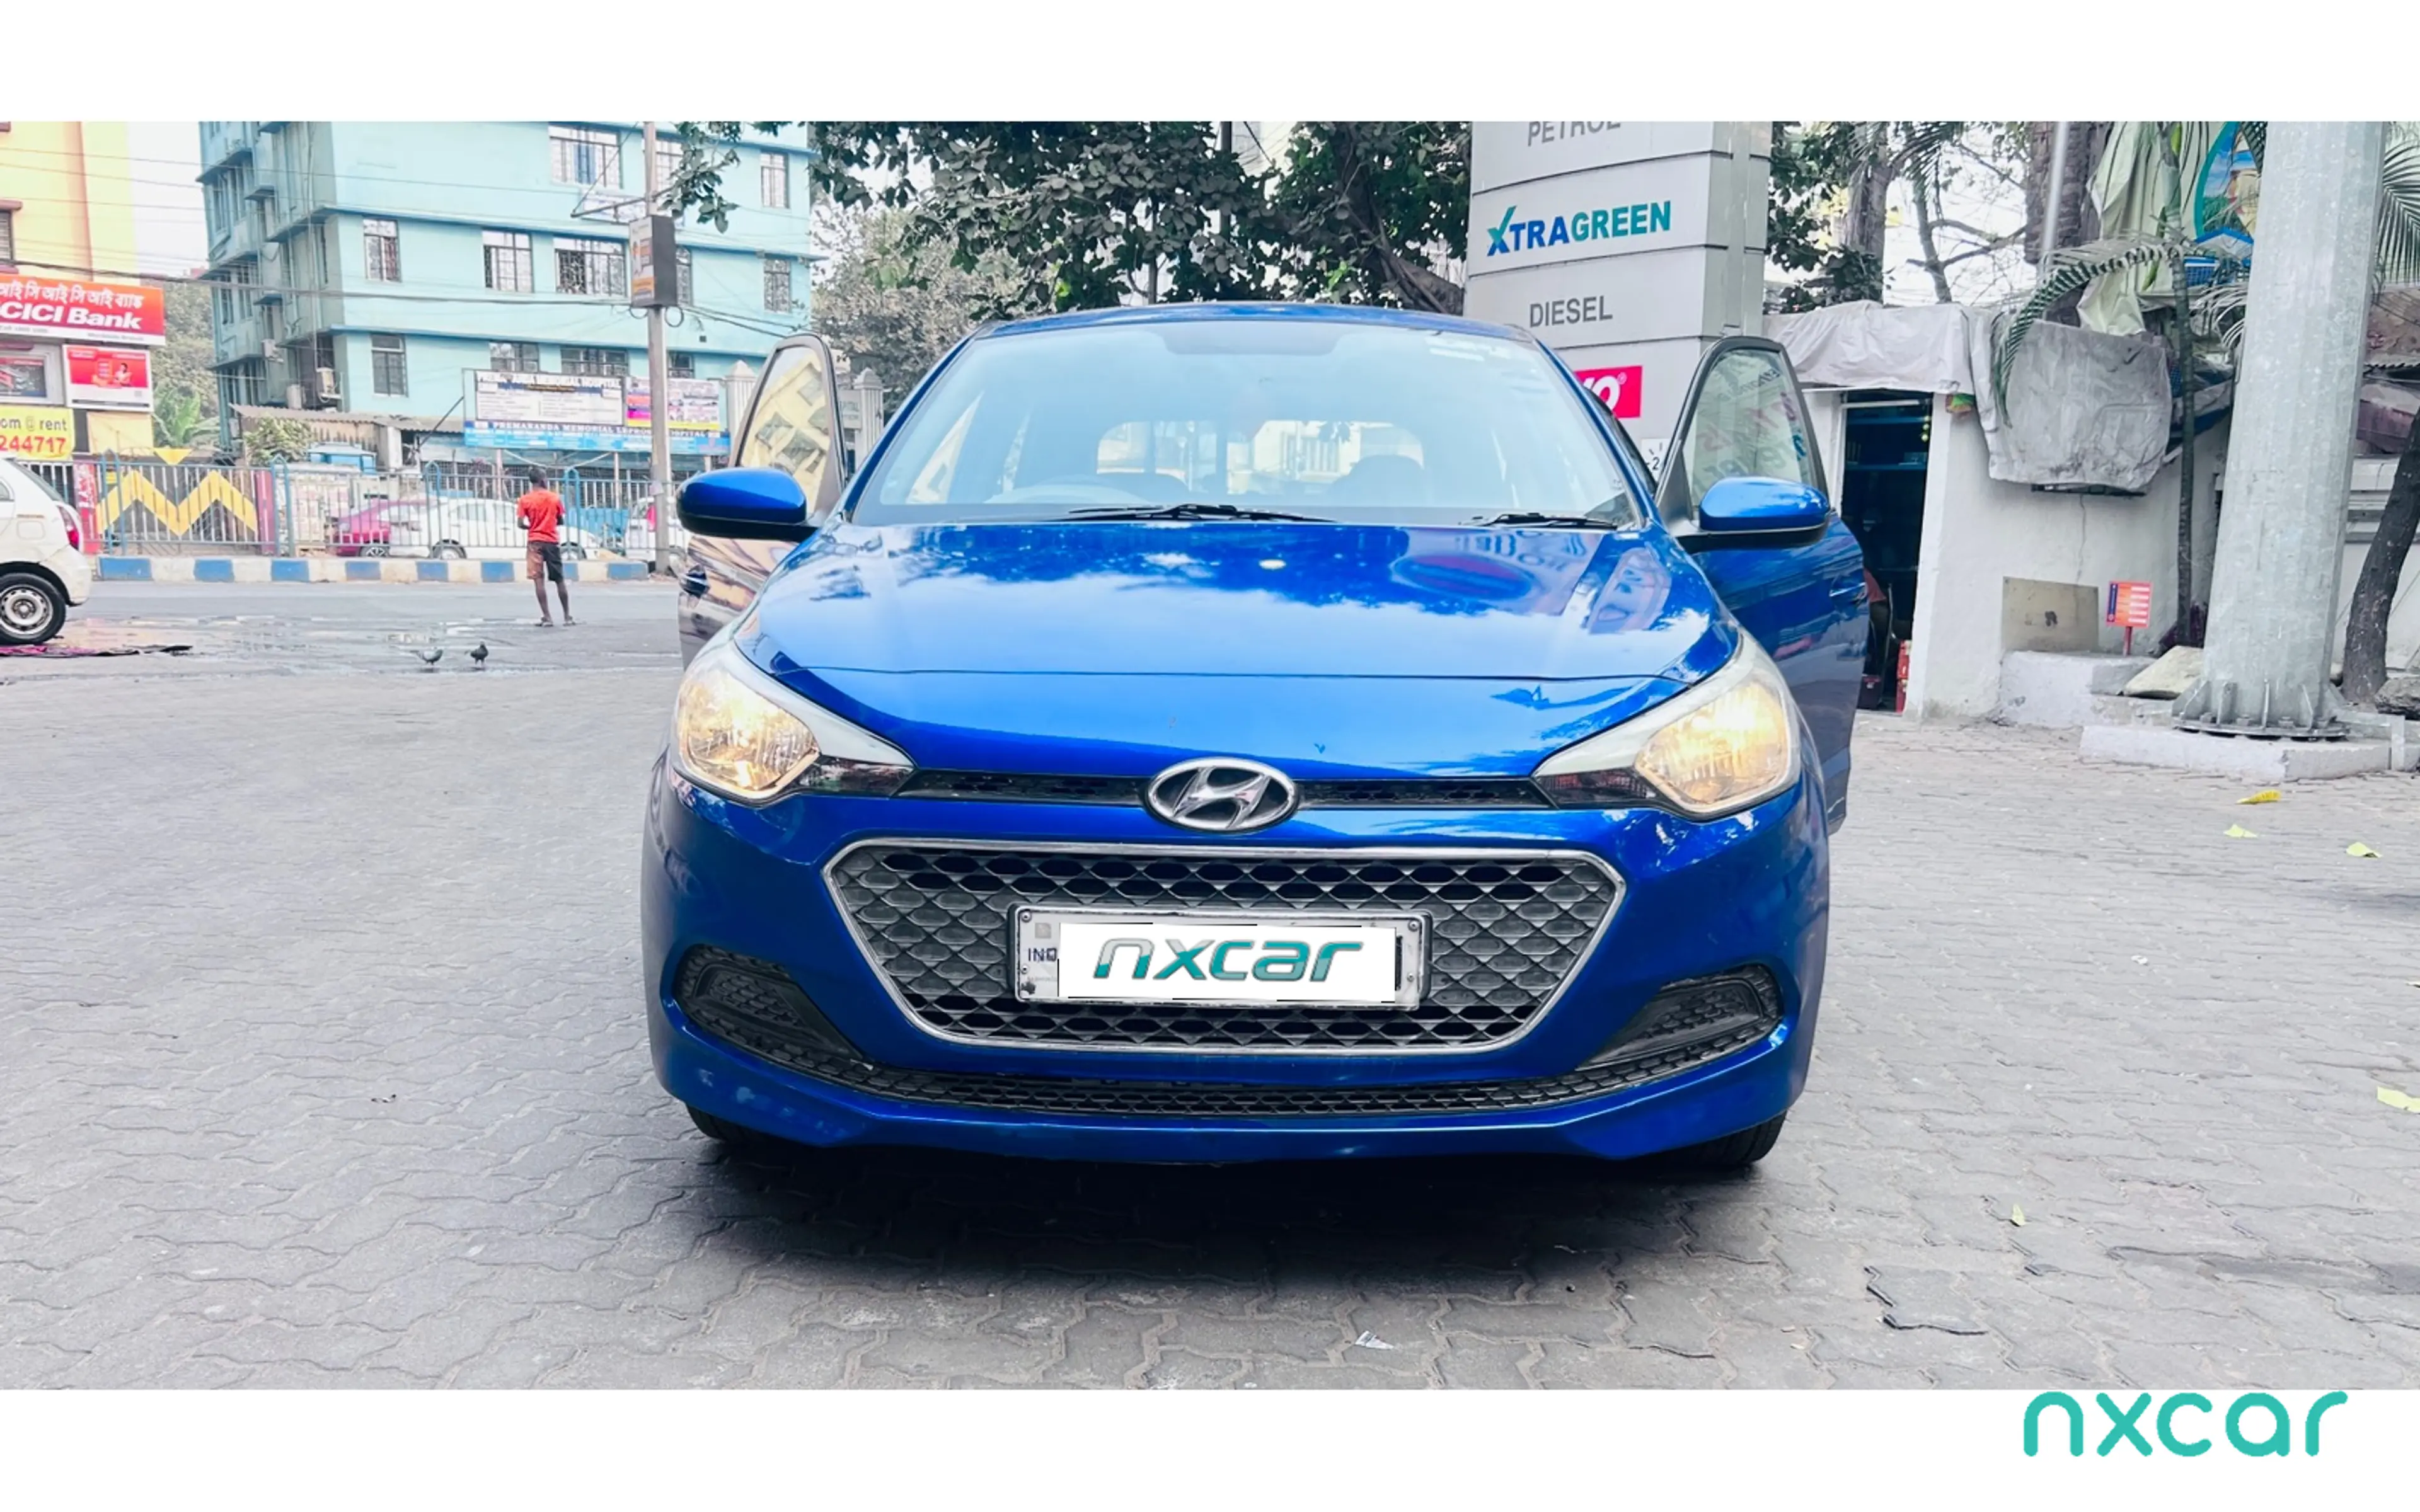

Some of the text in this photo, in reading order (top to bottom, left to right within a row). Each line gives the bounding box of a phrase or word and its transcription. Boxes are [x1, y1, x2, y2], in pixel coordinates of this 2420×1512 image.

[1487, 200, 1671, 257] XTRAGREEN
[67, 307, 143, 329] Bank
[1530, 295, 1613, 328] DIESEL
[40, 418, 67, 432] rent
